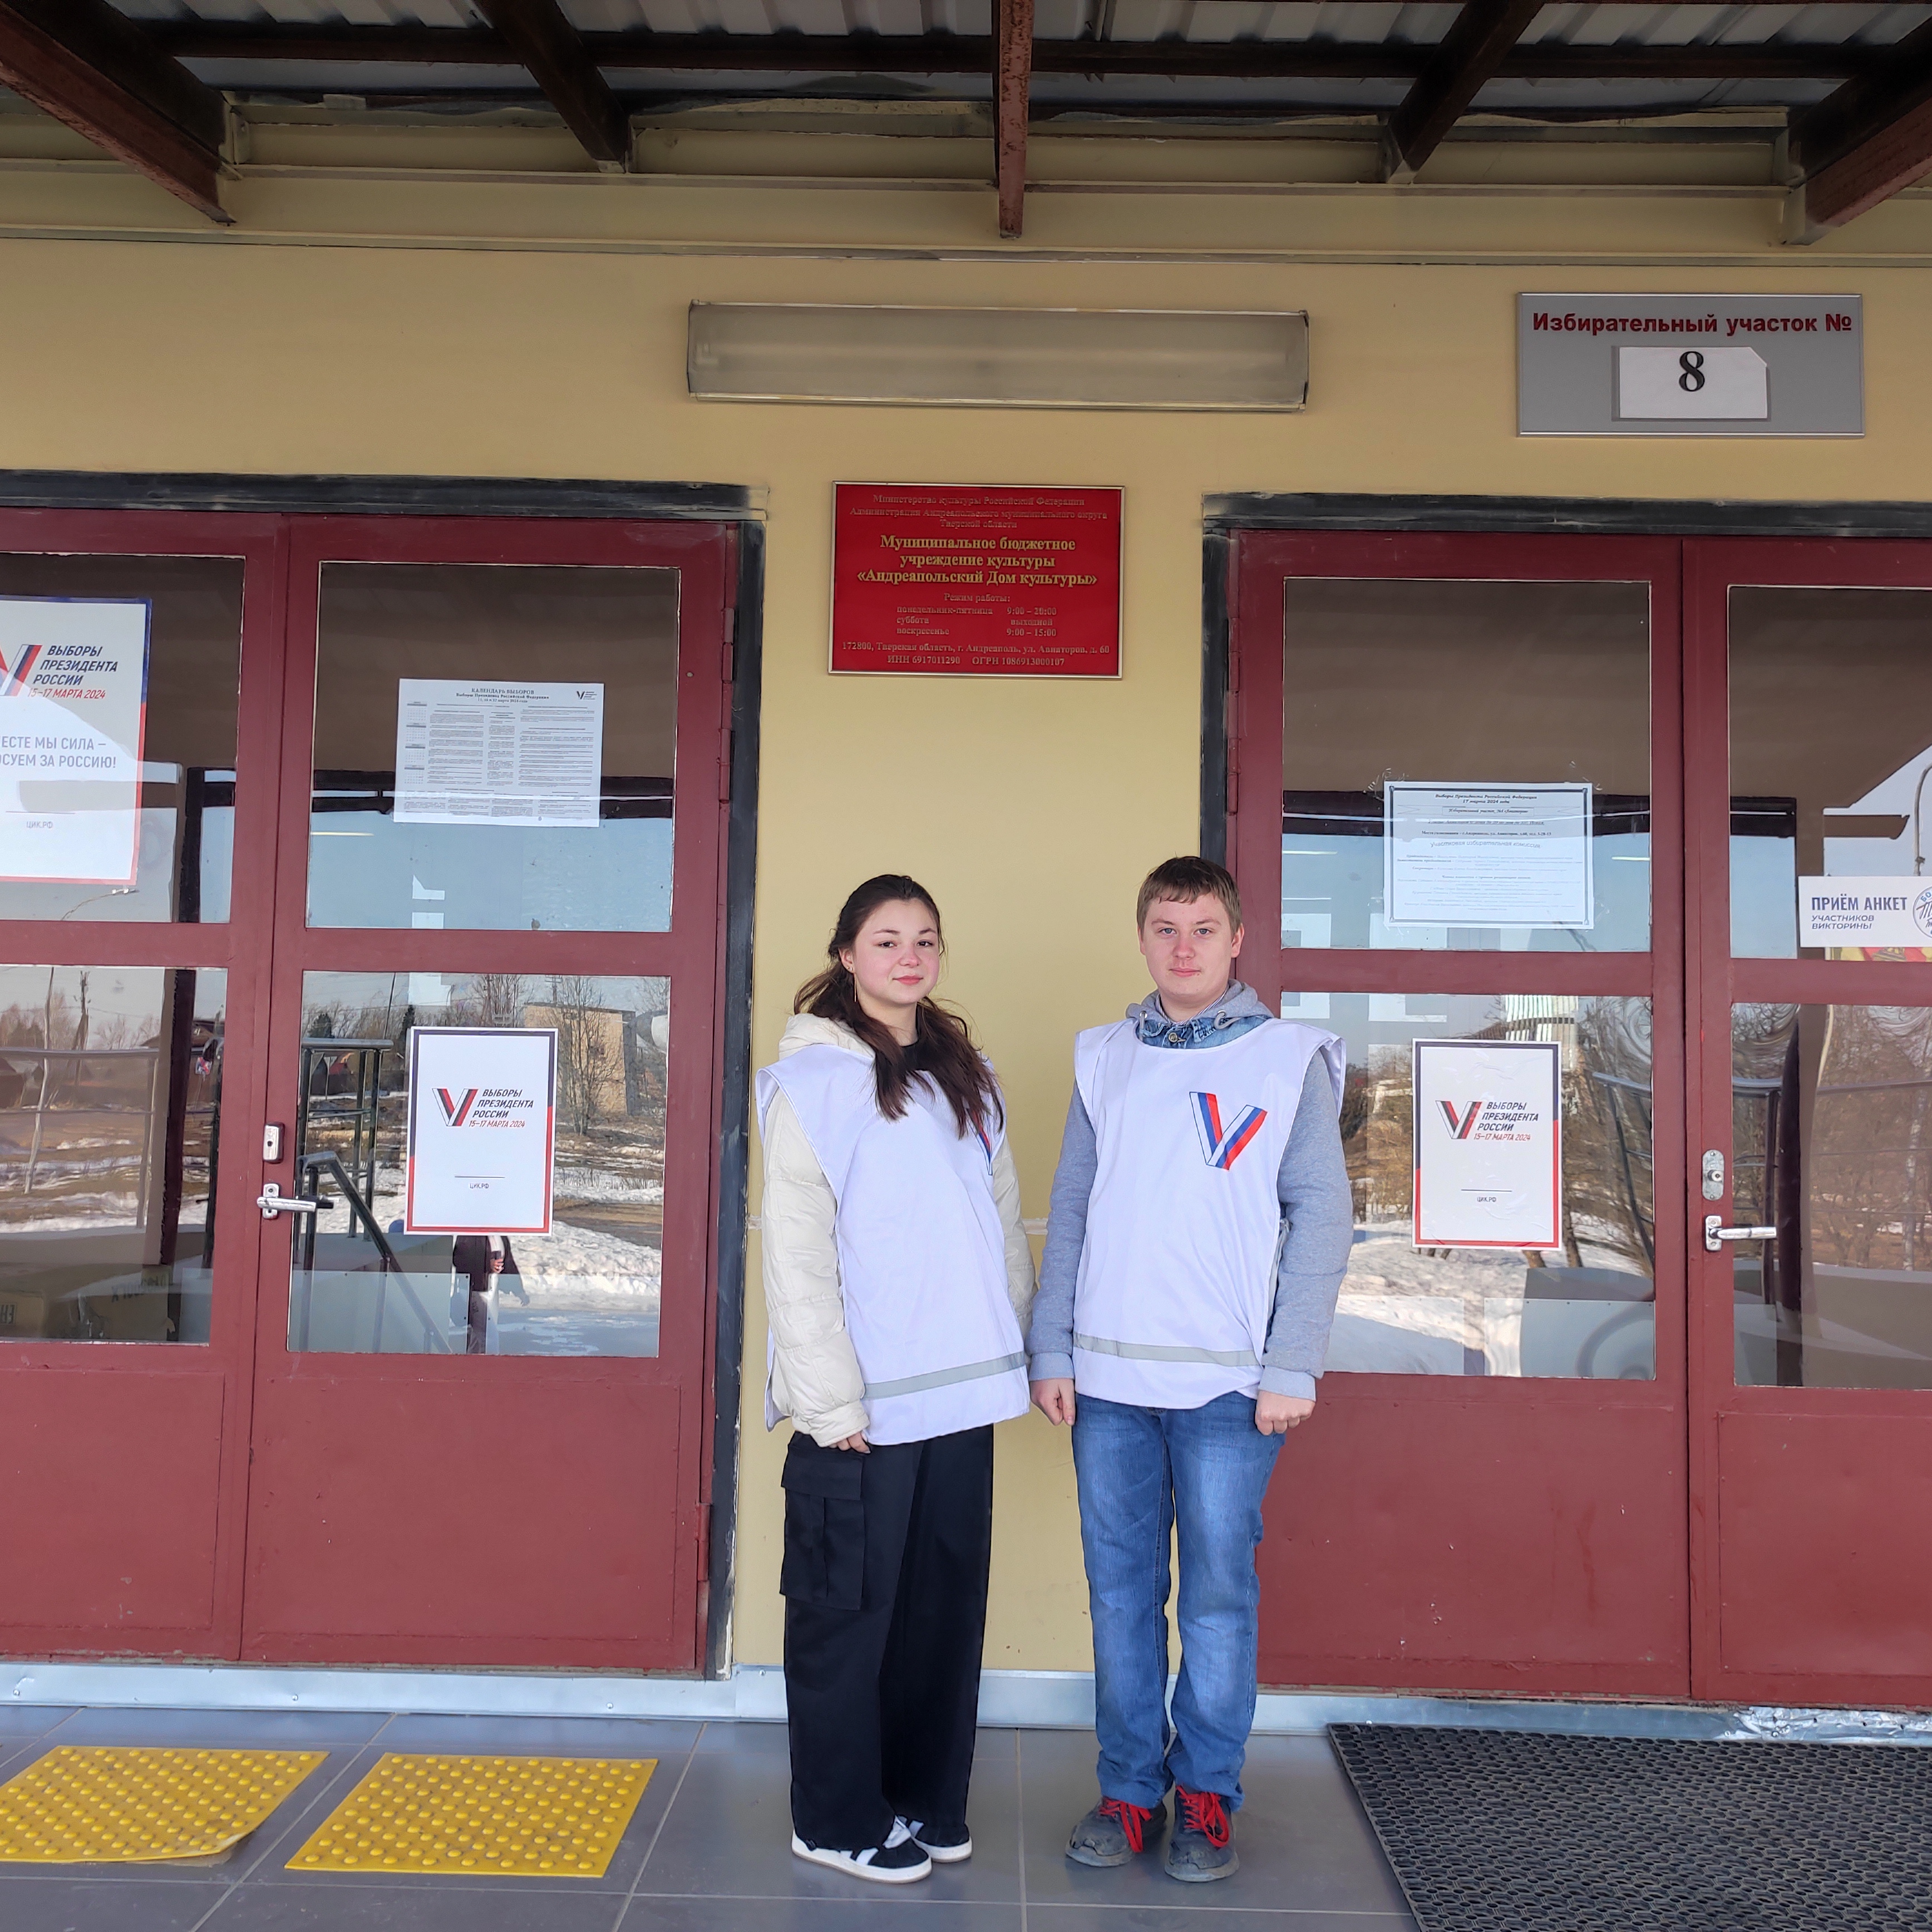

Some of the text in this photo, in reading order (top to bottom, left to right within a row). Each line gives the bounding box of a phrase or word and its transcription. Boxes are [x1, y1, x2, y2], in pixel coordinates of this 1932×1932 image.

[1533, 313, 1852, 336] Избирательный участок №
[1679, 351, 1705, 392] 8
[880, 535, 1076, 551] Муниципальное бюджетное
[900, 555, 1055, 570] учреждение культуры
[857, 569, 1097, 587] «Андреапольский Дом культуры»
[944, 593, 1010, 603] Режим работы:
[897, 617, 929, 625] суббота
[47, 645, 103, 657] ВЫБОРЫ
[842, 642, 874, 651] 172800,
[876, 642, 916, 652] Тверская
[919, 644, 955, 653] область,
[40, 660, 118, 672] ПРЕЗИДЕНТА
[888, 655, 909, 664] ИНН
[912, 656, 960, 664] 6917011290
[1002, 658, 1064, 666] 1086913000107
[33, 674, 84, 685] РОССИИ
[52, 689, 83, 698] МАРТА
[83, 689, 106, 699] 2024
[0, 736, 31, 748] ЕСТЕ
[35, 737, 57, 749] МЫ
[61, 737, 94, 750] СИЛА
[0, 754, 116, 768] СУЕМ ЗА РОССИЮ!
[26, 821, 53, 829] ЦИК.РФ
[1811, 893, 1908, 910] ПРИЁМ АНКЕТ
[482, 1089, 523, 1097] ВЫБОРЫ
[477, 1100, 534, 1108] ПРЕЗИДЕНТА
[1486, 1102, 1527, 1110] ВЫБОРЫ
[1481, 1112, 1539, 1121] ПРЕЗИДЕНТА
